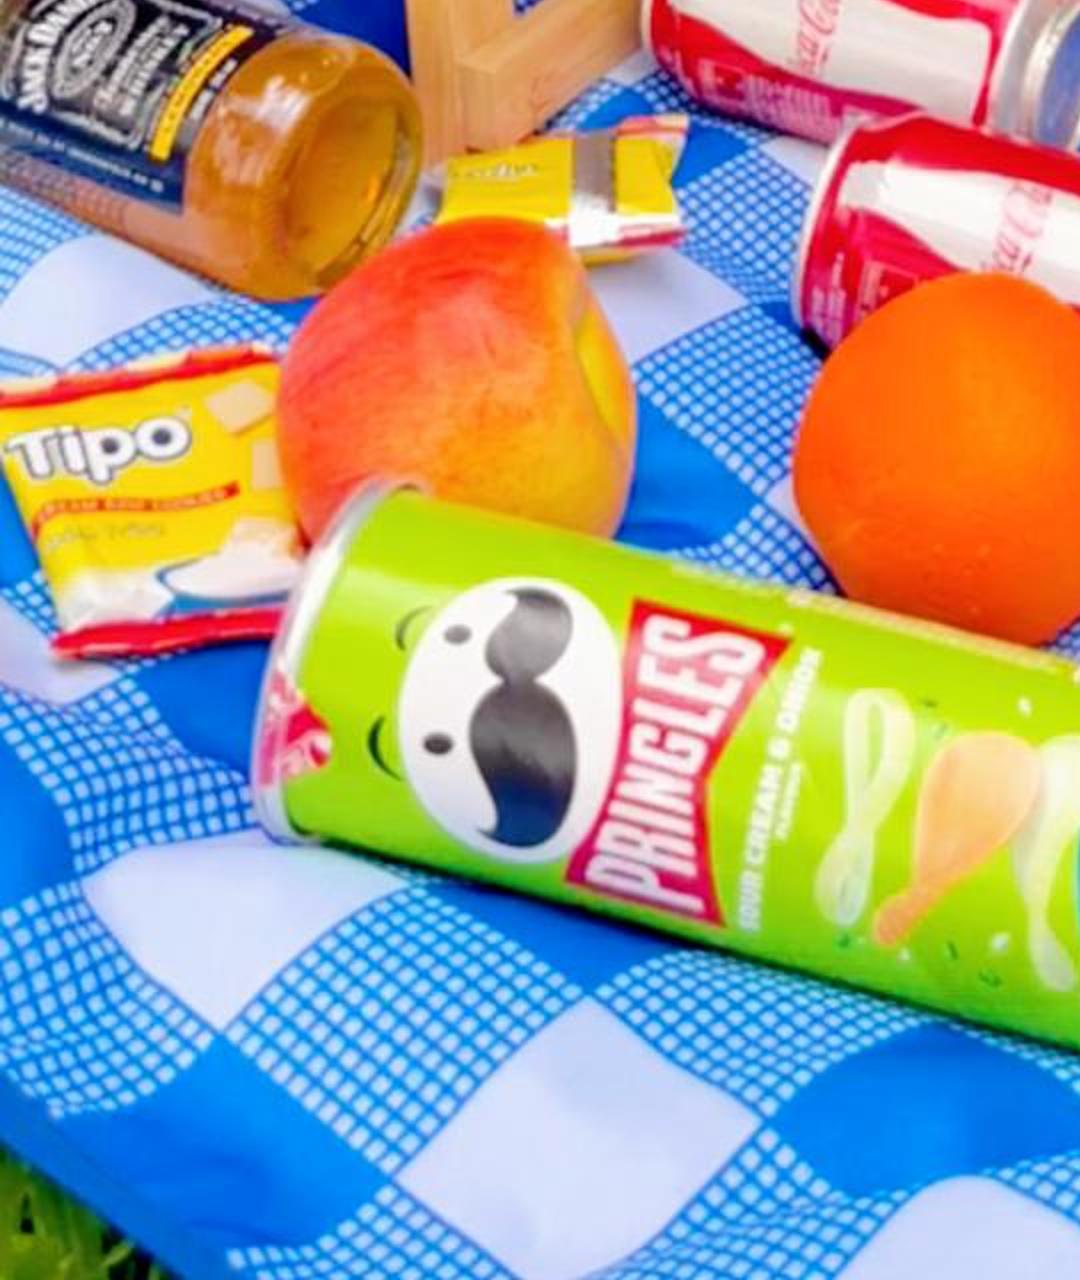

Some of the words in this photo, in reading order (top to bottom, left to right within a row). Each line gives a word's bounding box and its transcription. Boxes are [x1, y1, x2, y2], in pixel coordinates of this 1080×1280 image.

[4, 416, 191, 485] Tipo
[585, 613, 765, 913] PRINGLES
[746, 763, 780, 866] CREAM
